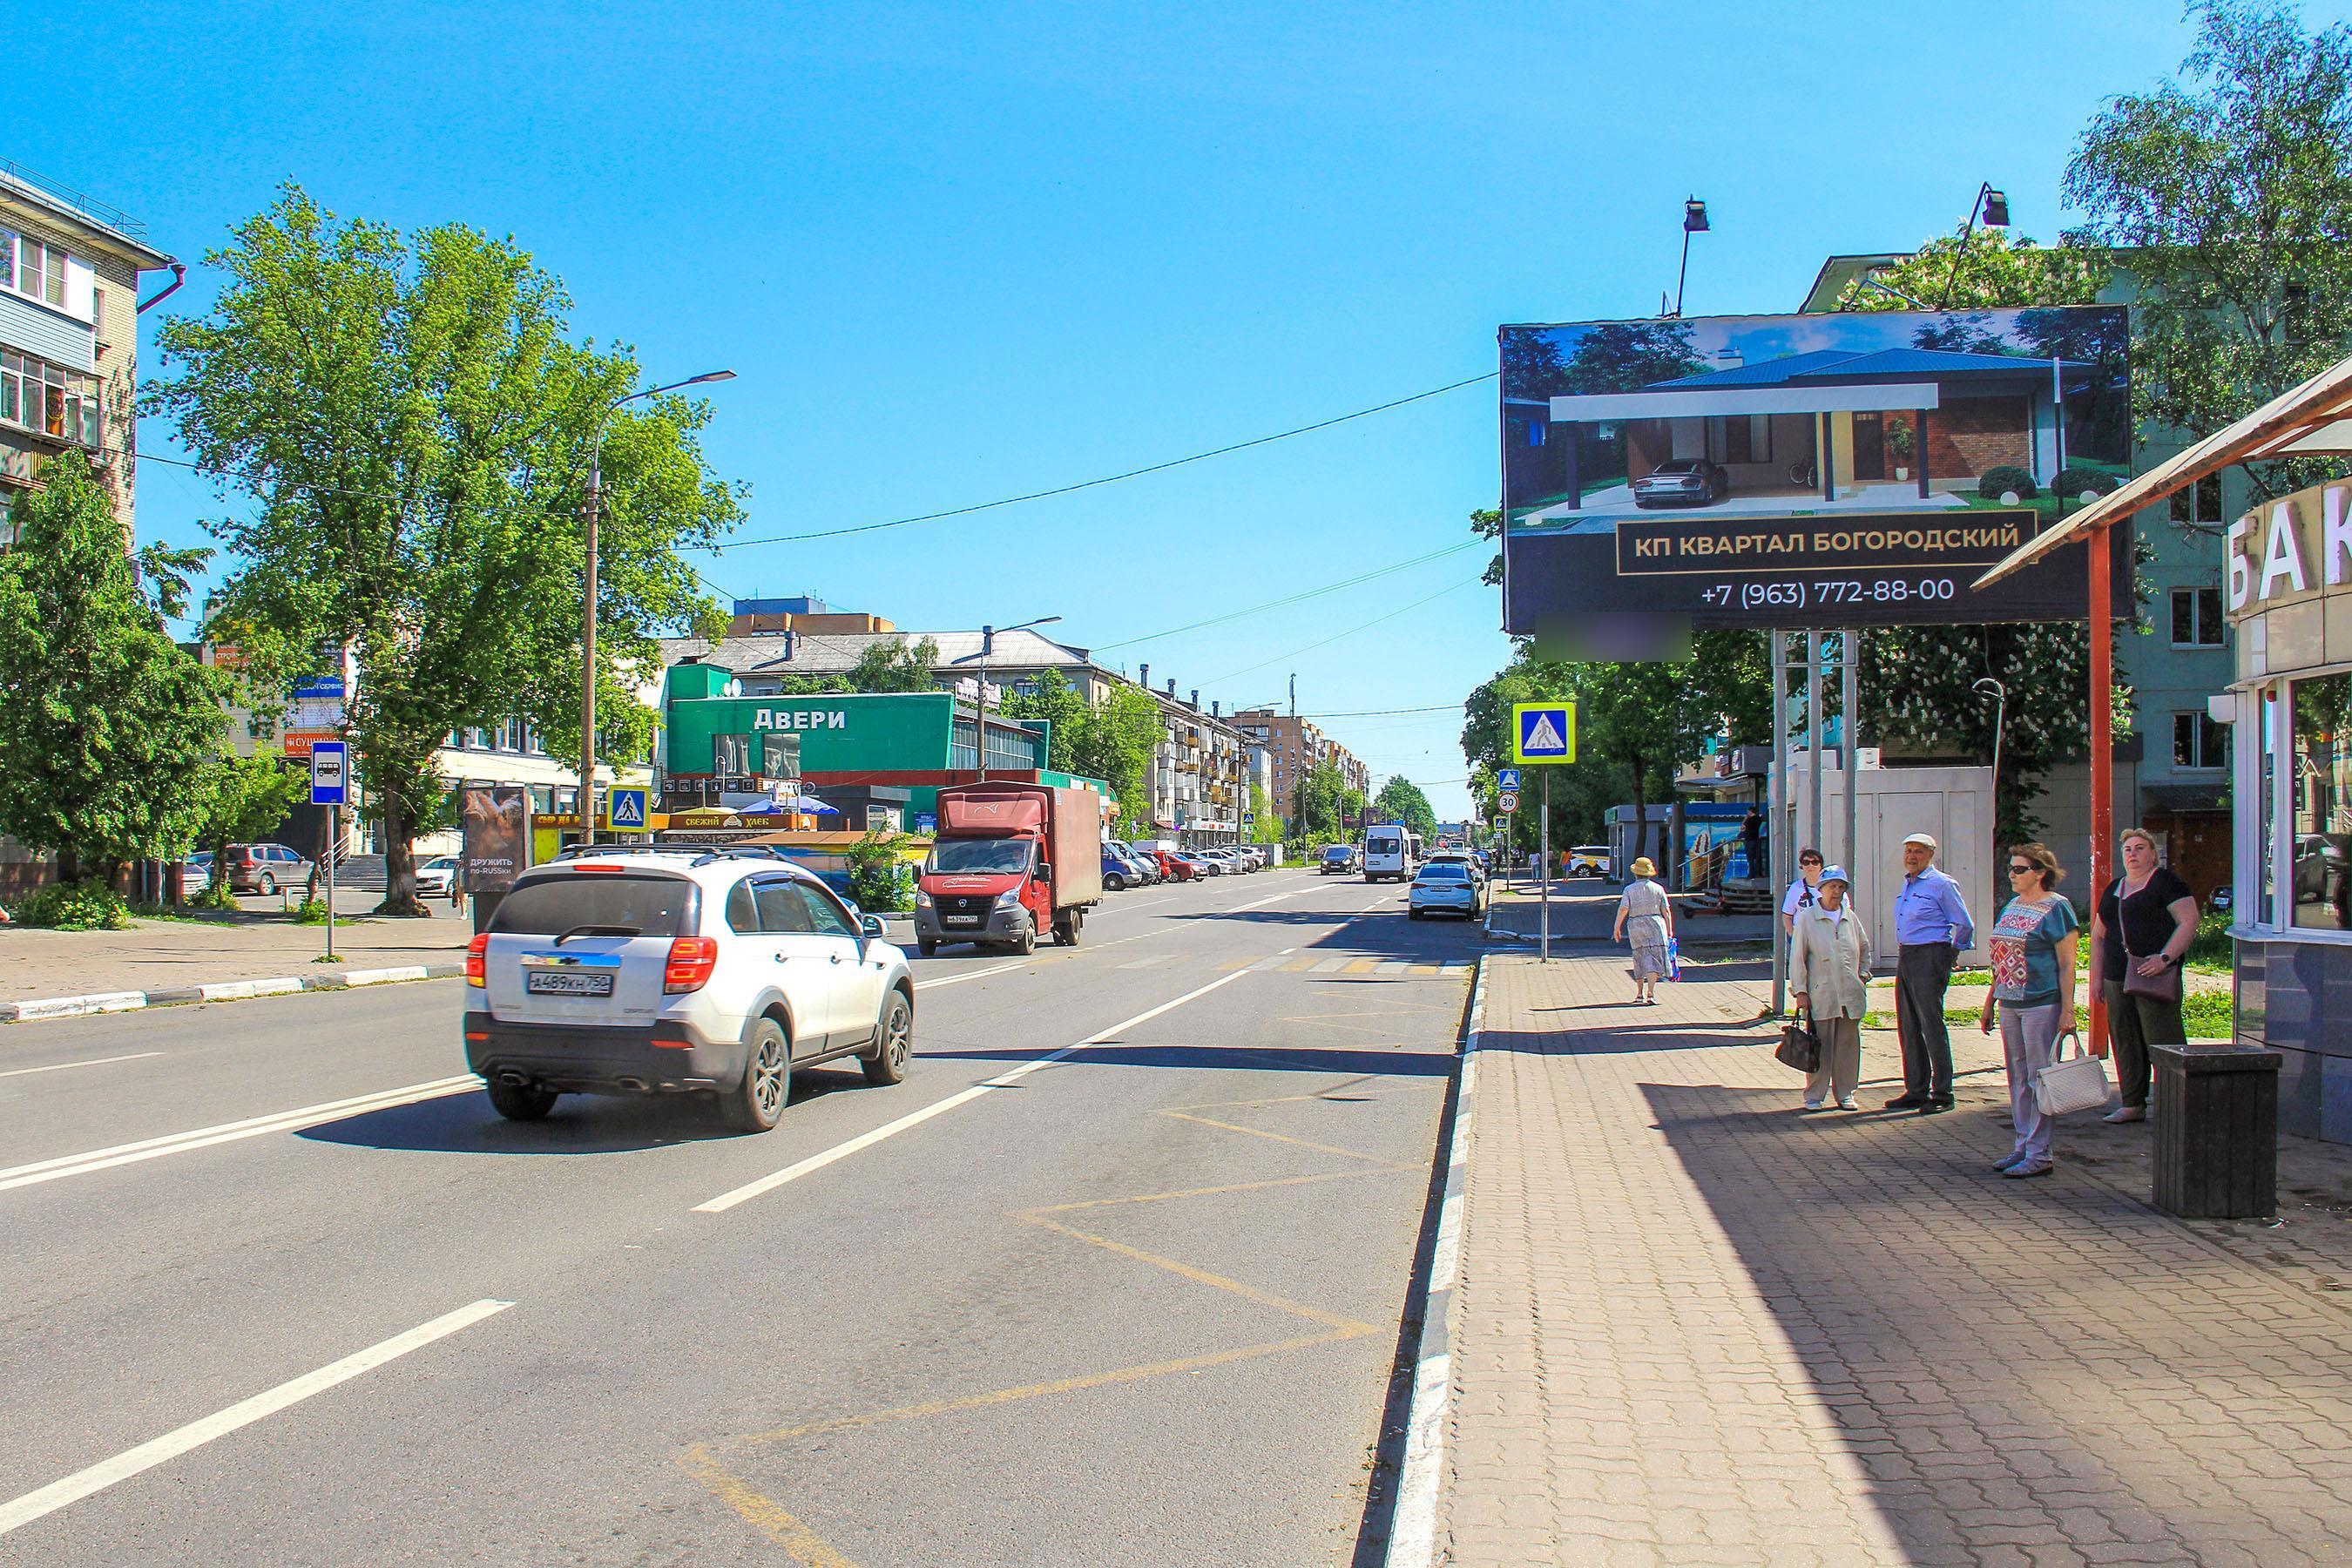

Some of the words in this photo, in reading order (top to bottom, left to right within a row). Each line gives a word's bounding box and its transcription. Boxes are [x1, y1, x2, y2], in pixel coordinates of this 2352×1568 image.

[1635, 537, 1671, 558] КП
[1680, 533, 1805, 556] КВАРТАЛ
[1814, 523, 2018, 551] БОГОРОДСКИЙ
[1701, 585, 1732, 605] +7
[1741, 581, 1806, 610] (963)
[1814, 578, 1955, 603] 772-88-00
[754, 708, 846, 730] ДВЕРИ
[1502, 798, 1514, 807] 30
[685, 816, 720, 826] СВЕЖИЙ
[746, 817, 769, 828] ХЛЕБ
[470, 858, 513, 867] ДРУЖИТЬ
